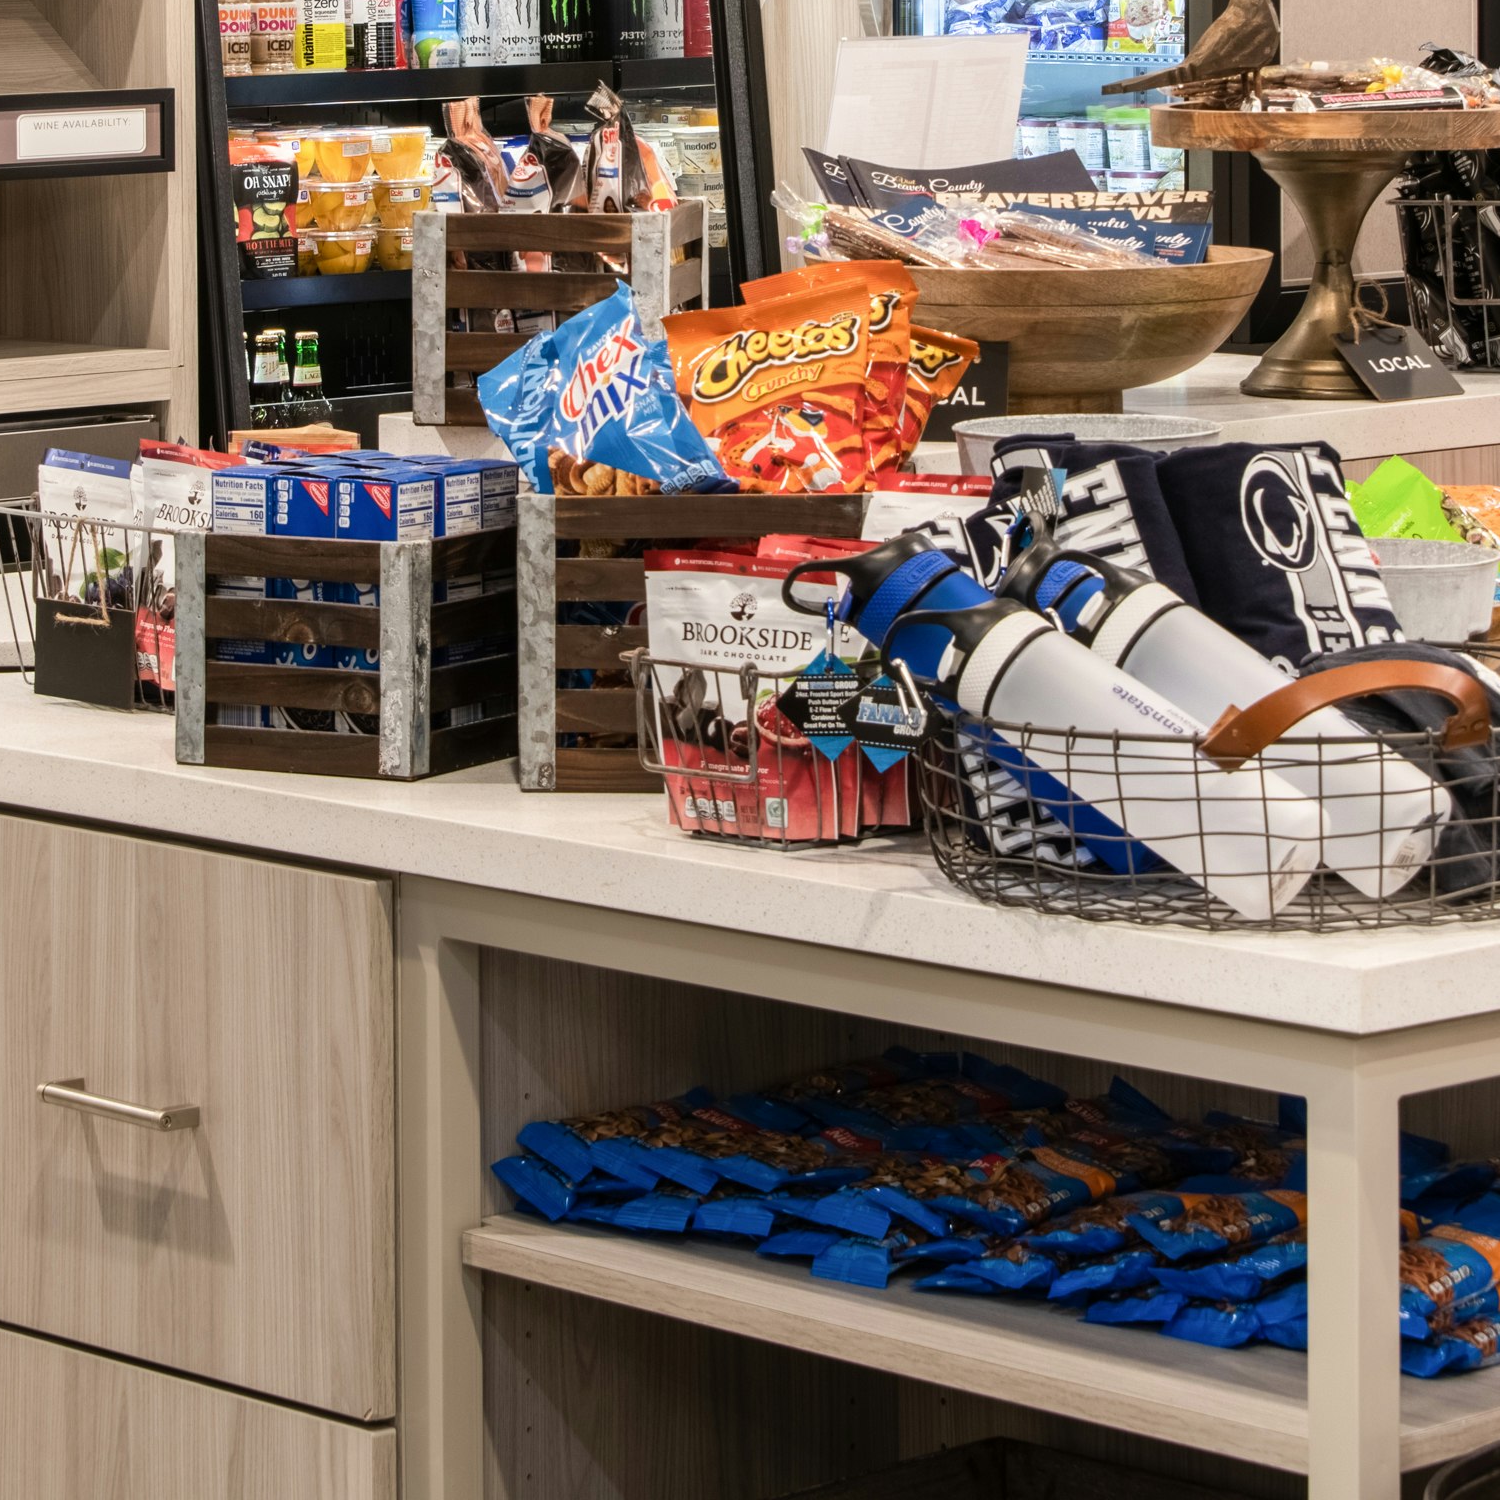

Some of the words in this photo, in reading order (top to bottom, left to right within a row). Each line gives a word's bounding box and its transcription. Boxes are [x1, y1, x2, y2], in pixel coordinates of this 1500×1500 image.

[314, 0, 339, 9] zero
[33, 120, 59, 130] WINE
[62, 118, 131, 129] AVAILABILITY:
[244, 176, 260, 190] OH
[929, 178, 985, 193] County
[691, 315, 861, 403] Cheetos
[1367, 354, 1431, 374] LOCAL
[563, 318, 638, 420] Chex
[742, 362, 824, 401] Crunchy
[581, 355, 647, 446] mix
[215, 478, 244, 489] Nutrition
[246, 481, 263, 490] Facts
[215, 510, 239, 519] Calories
[249, 510, 264, 520] 160
[470, 505, 480, 513] 160
[423, 512, 433, 521] 160
[682, 621, 812, 651] BROOKSIDE
[724, 651, 788, 663] CHOCOLATE
